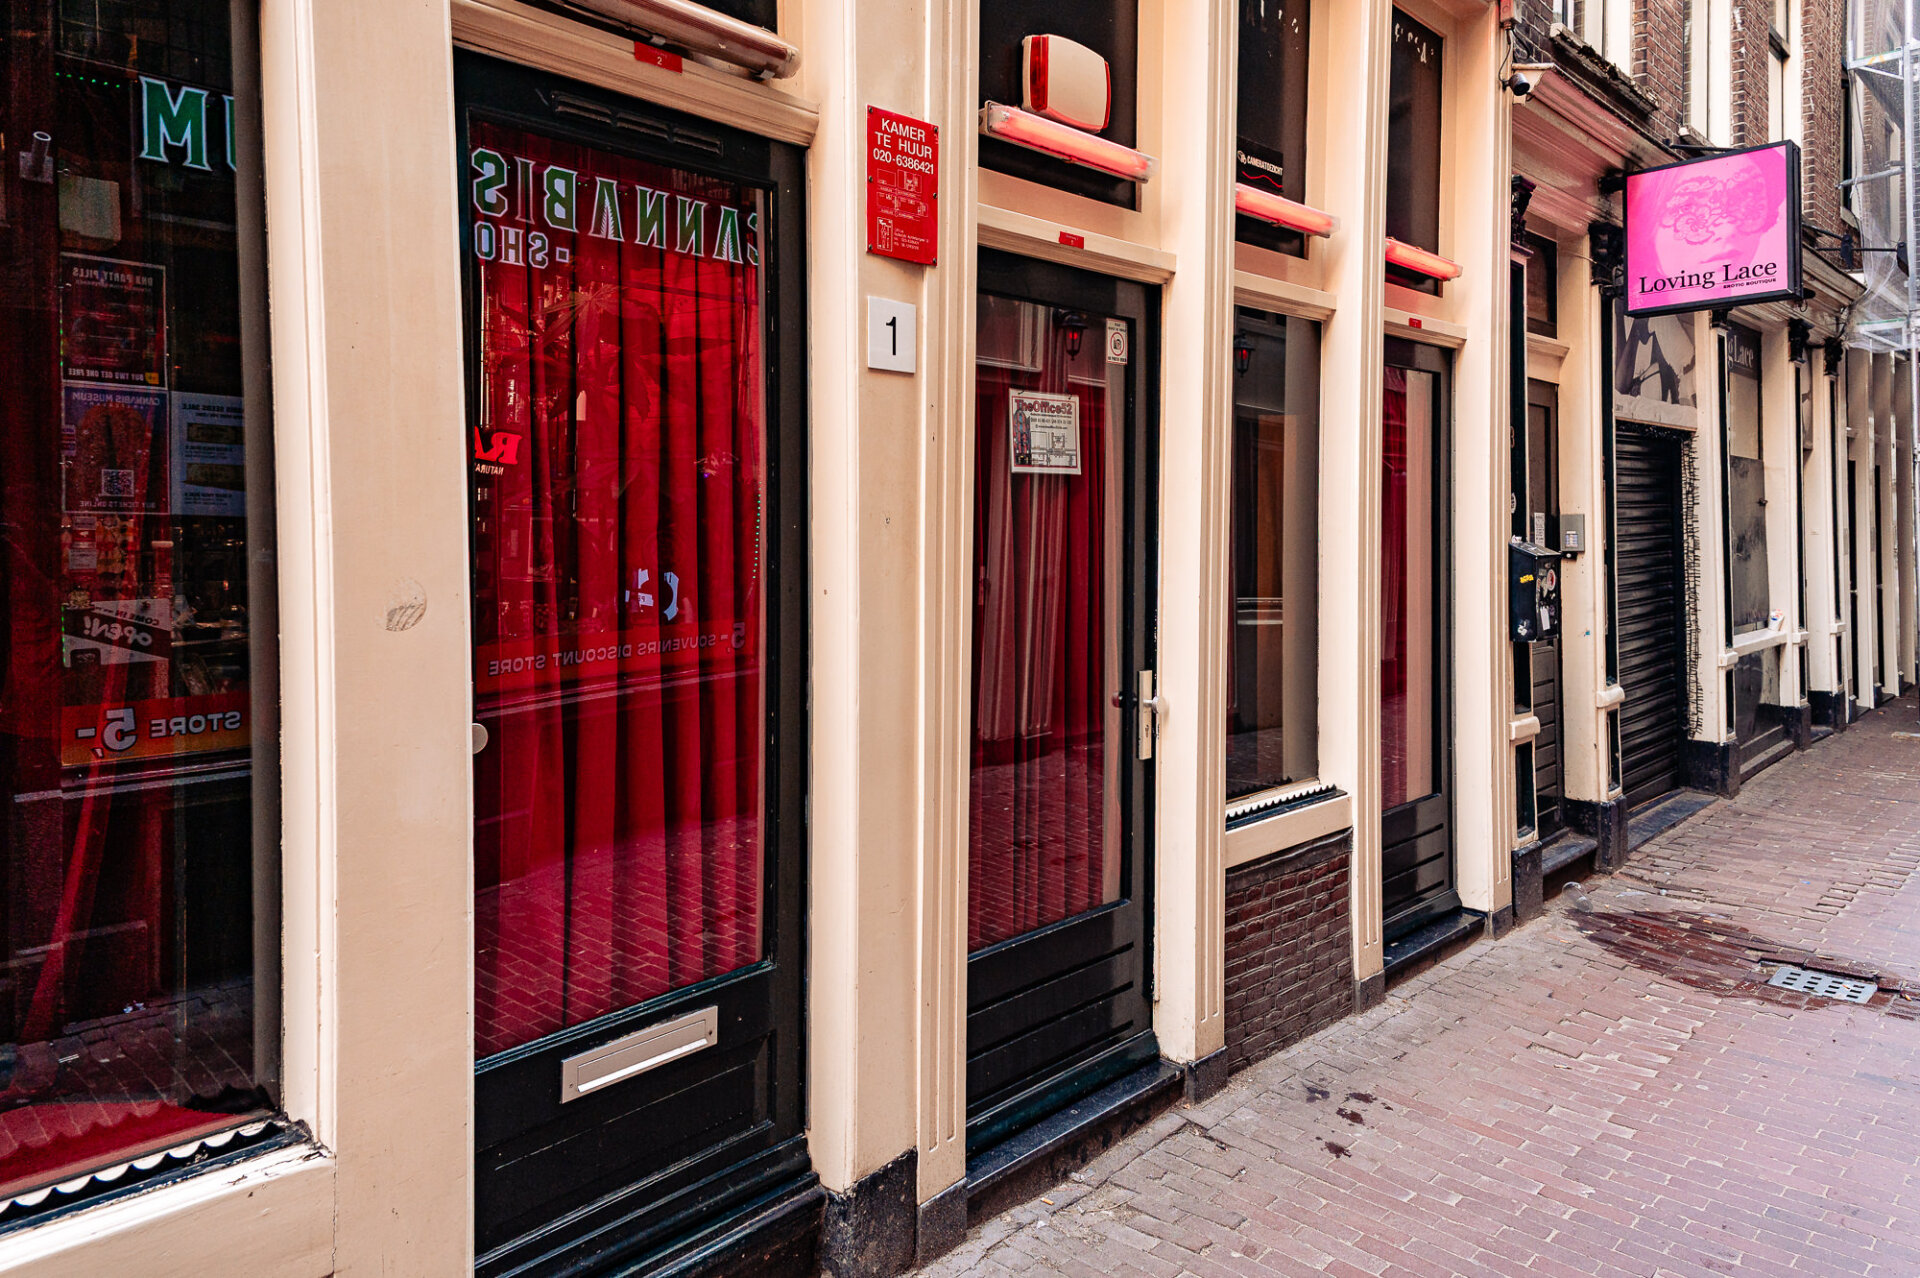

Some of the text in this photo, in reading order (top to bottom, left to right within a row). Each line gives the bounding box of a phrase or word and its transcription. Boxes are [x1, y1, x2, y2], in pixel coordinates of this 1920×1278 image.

[657, 56, 663, 66] 2
[881, 118, 926, 142] KAMER
[875, 131, 932, 159] TE HUUR
[873, 148, 934, 175] 020-6386421
[1639, 262, 1777, 294] Loving Lace
[1746, 278, 1777, 286] BOUTIQUE
[886, 316, 897, 356] 1
